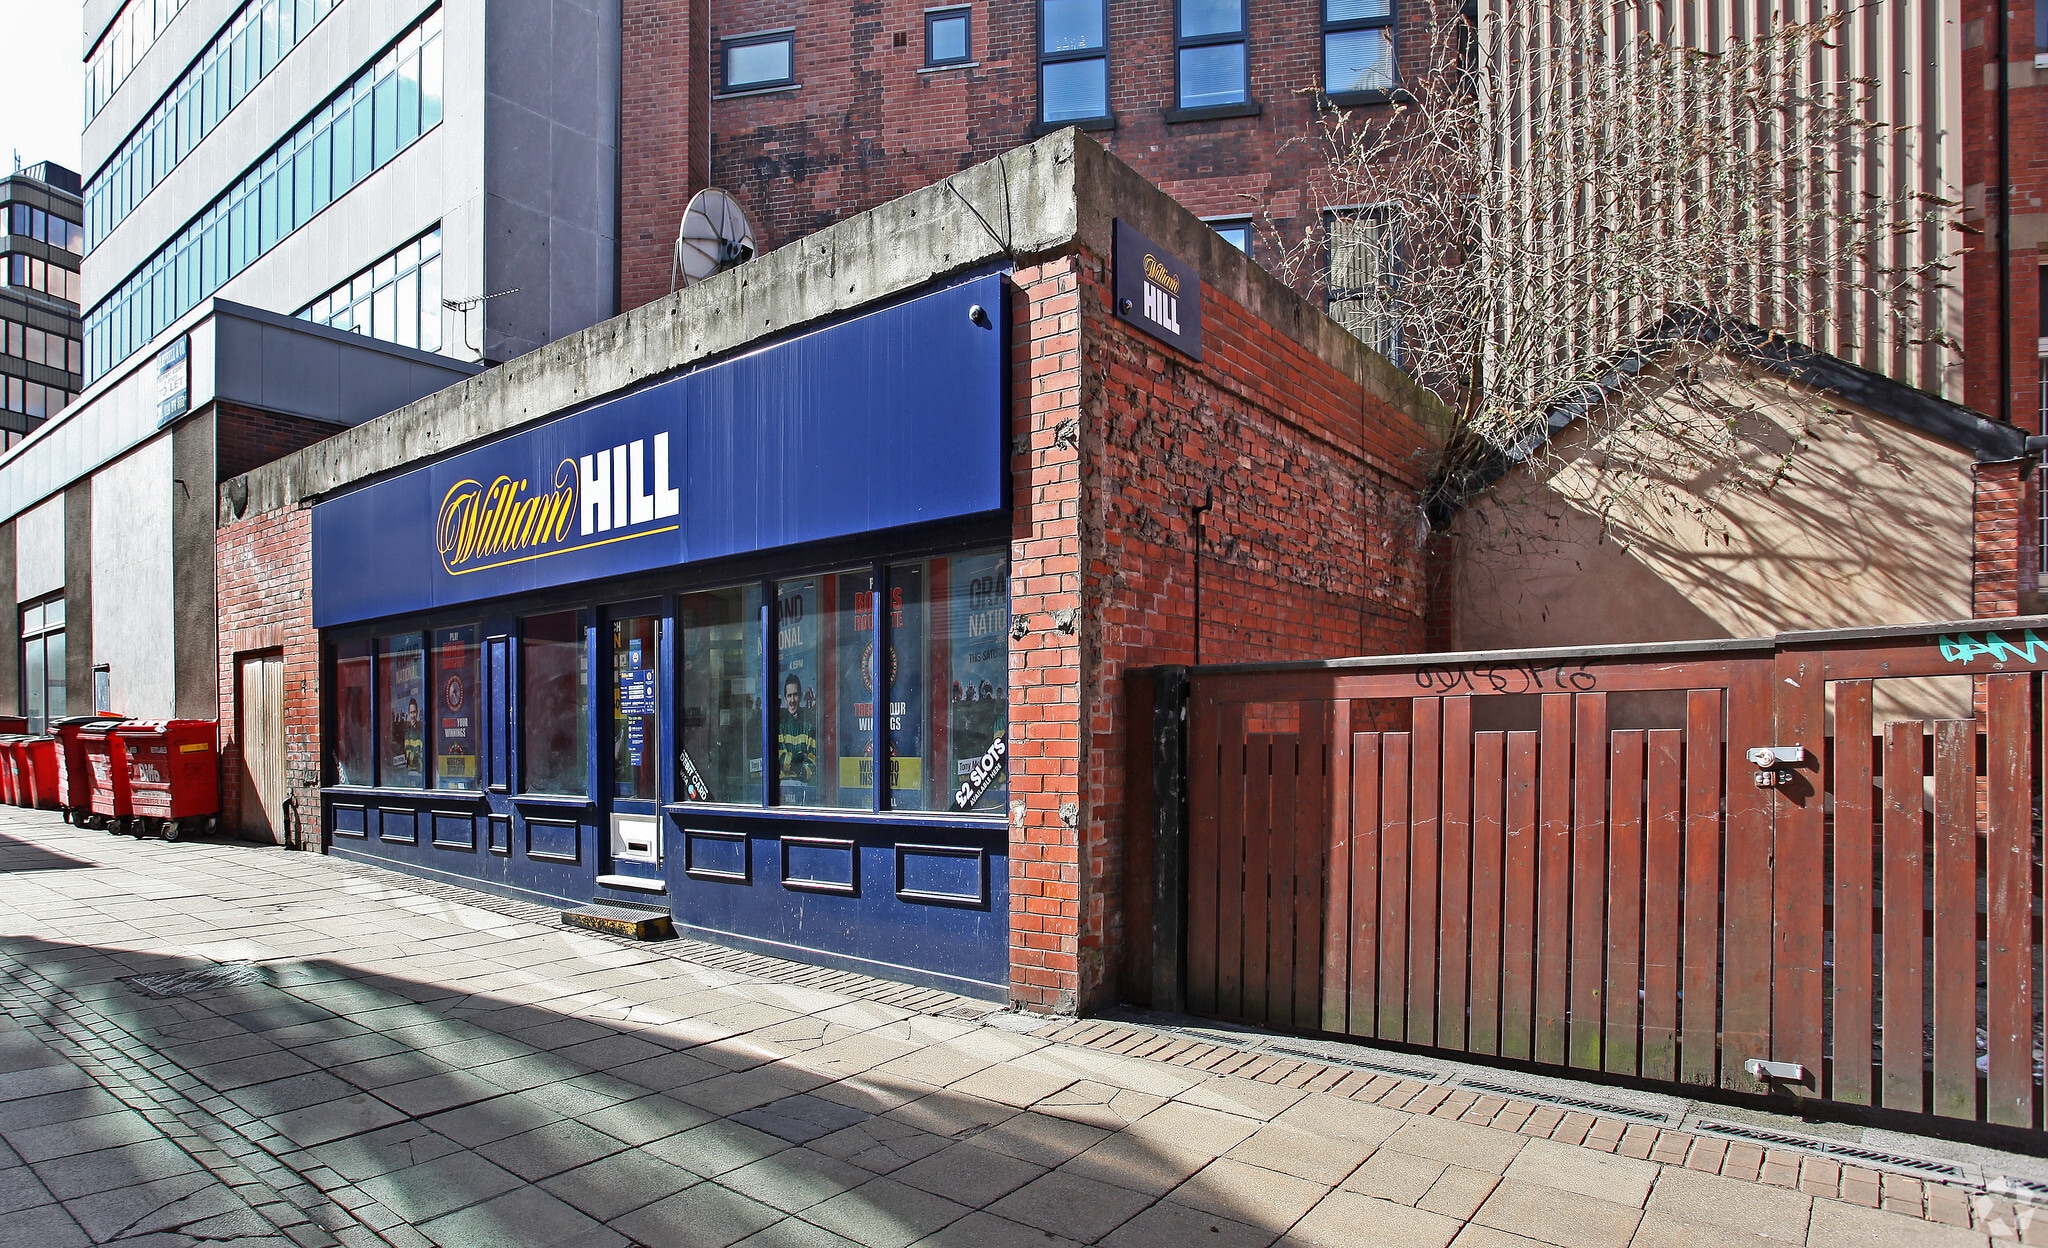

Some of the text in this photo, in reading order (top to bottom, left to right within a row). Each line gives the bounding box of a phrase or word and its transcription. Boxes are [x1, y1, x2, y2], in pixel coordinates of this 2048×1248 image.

[1143, 253, 1180, 294] William
[1143, 280, 1180, 336] HILL
[169, 377, 184, 391] LET
[436, 431, 679, 570] William HILL
[855, 587, 903, 614] BOS
[969, 571, 1006, 611] GRA
[968, 607, 1006, 638] NATIO
[982, 647, 1006, 660] SATURD
[138, 763, 160, 782] Biffa
[680, 752, 695, 777] DEBIT
[692, 775, 706, 800] CARD
[956, 738, 1006, 808] £2 SLOTS
[960, 760, 972, 772] Tony
[970, 776, 992, 807] AVAILABLE
[989, 762, 1002, 780] HERE
